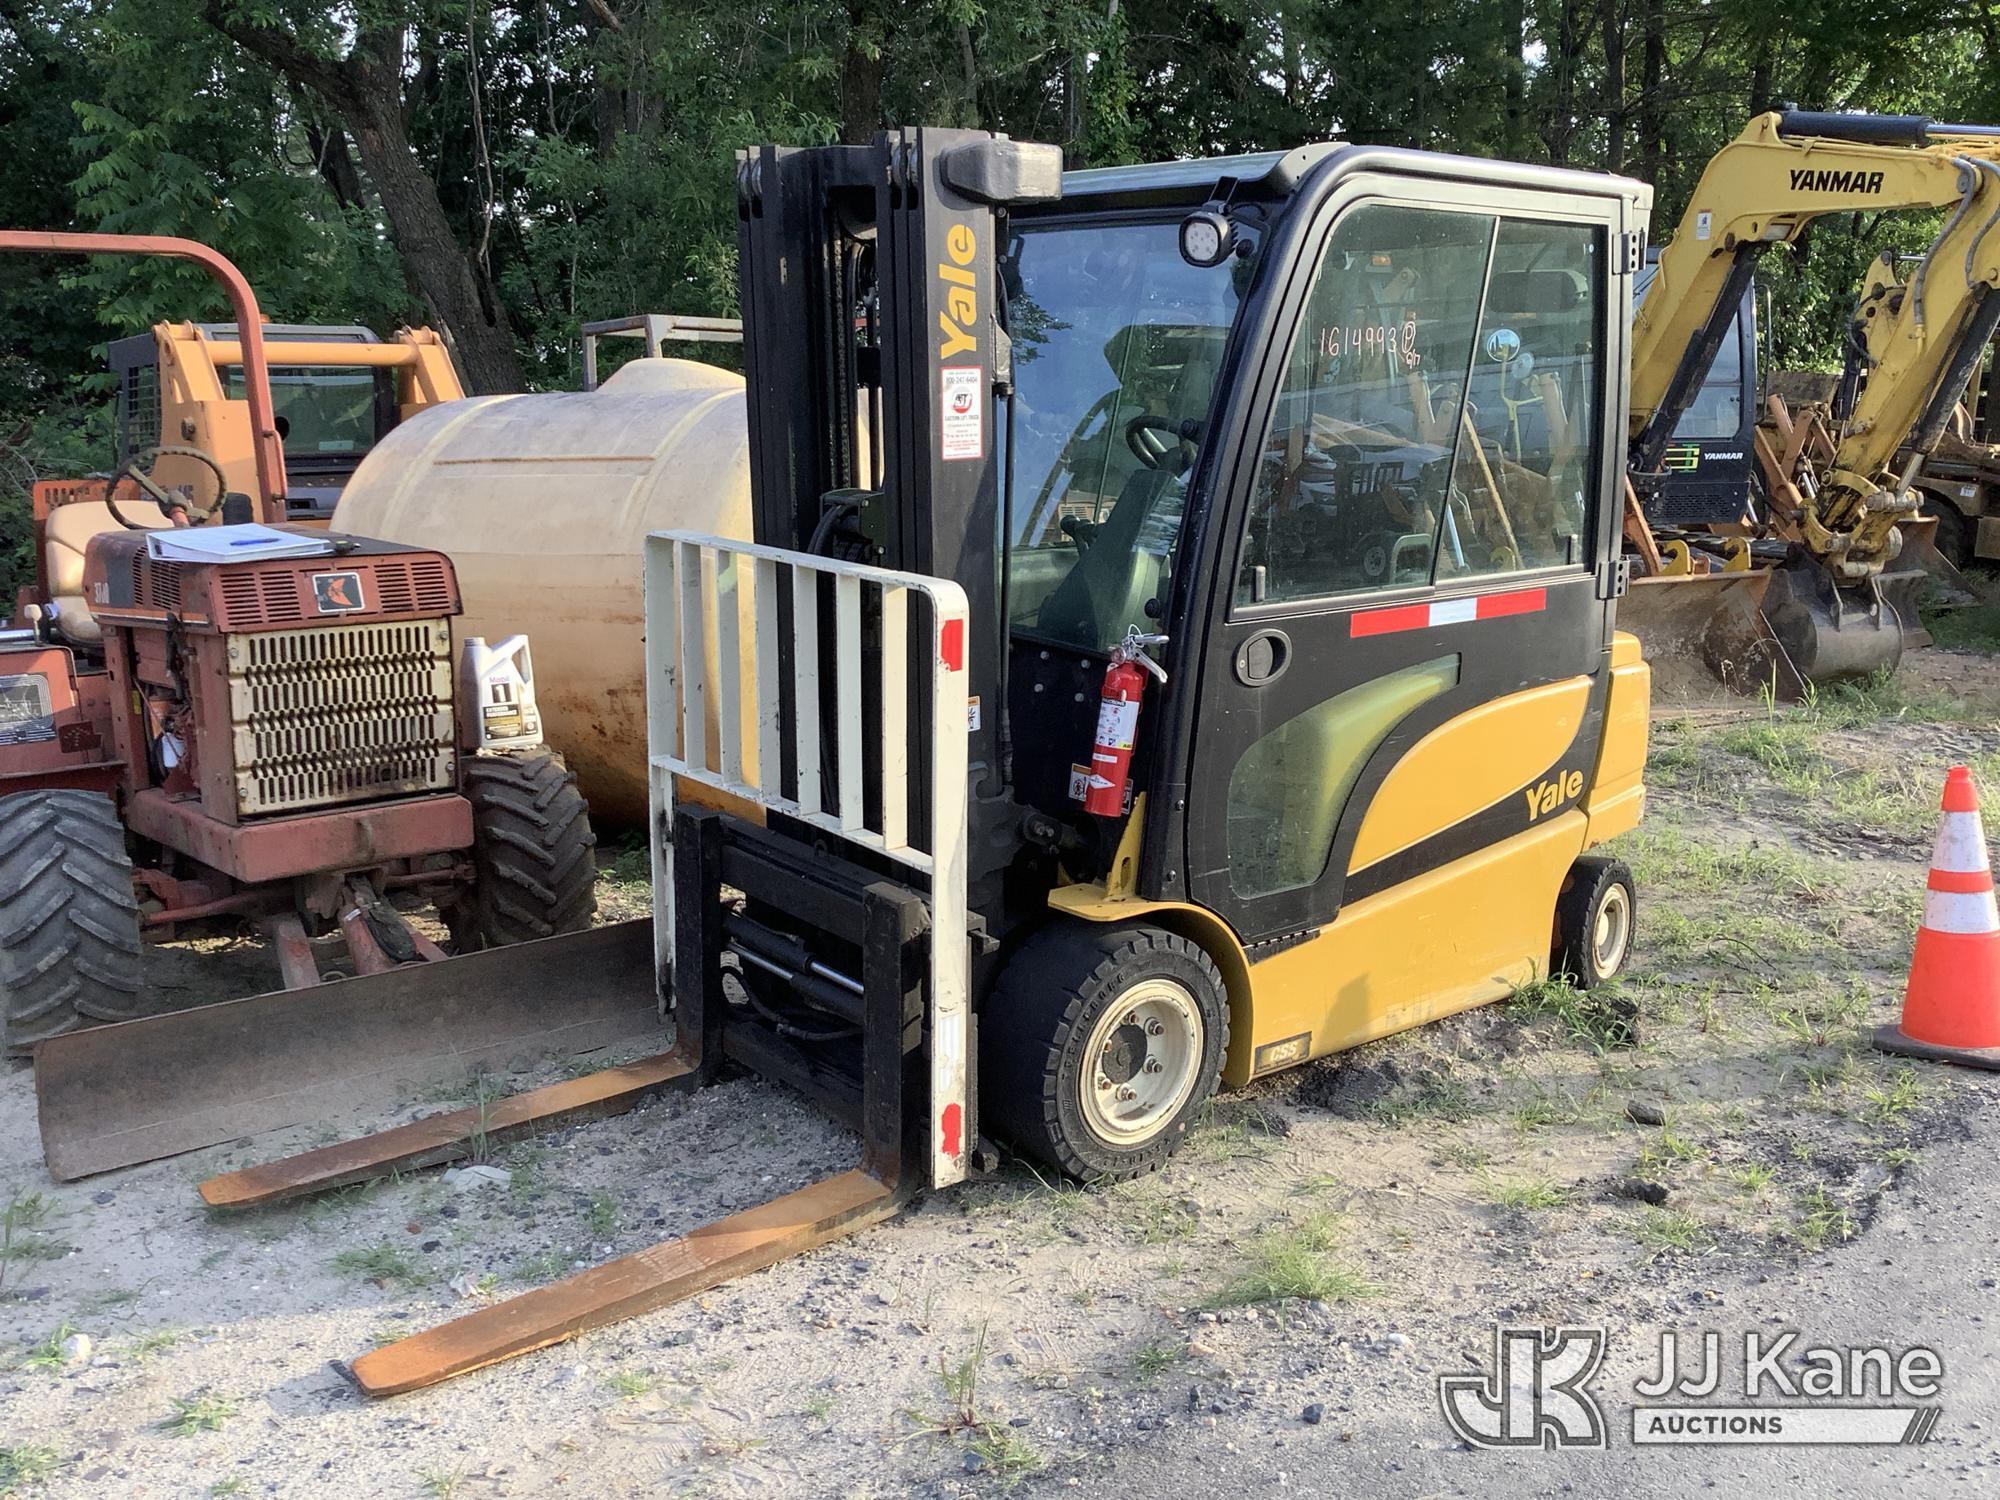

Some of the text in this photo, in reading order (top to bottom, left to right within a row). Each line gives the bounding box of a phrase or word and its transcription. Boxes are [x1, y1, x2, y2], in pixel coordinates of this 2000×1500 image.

[1790, 169, 1884, 194] YANMAR
[939, 223, 977, 361] Yale
[1320, 326, 1398, 357] 1614993
[1703, 452, 1743, 460] YANMAR
[489, 675, 510, 683] Mobil
[1525, 769, 1584, 822] Yale
[1270, 1041, 1298, 1062] CSS
